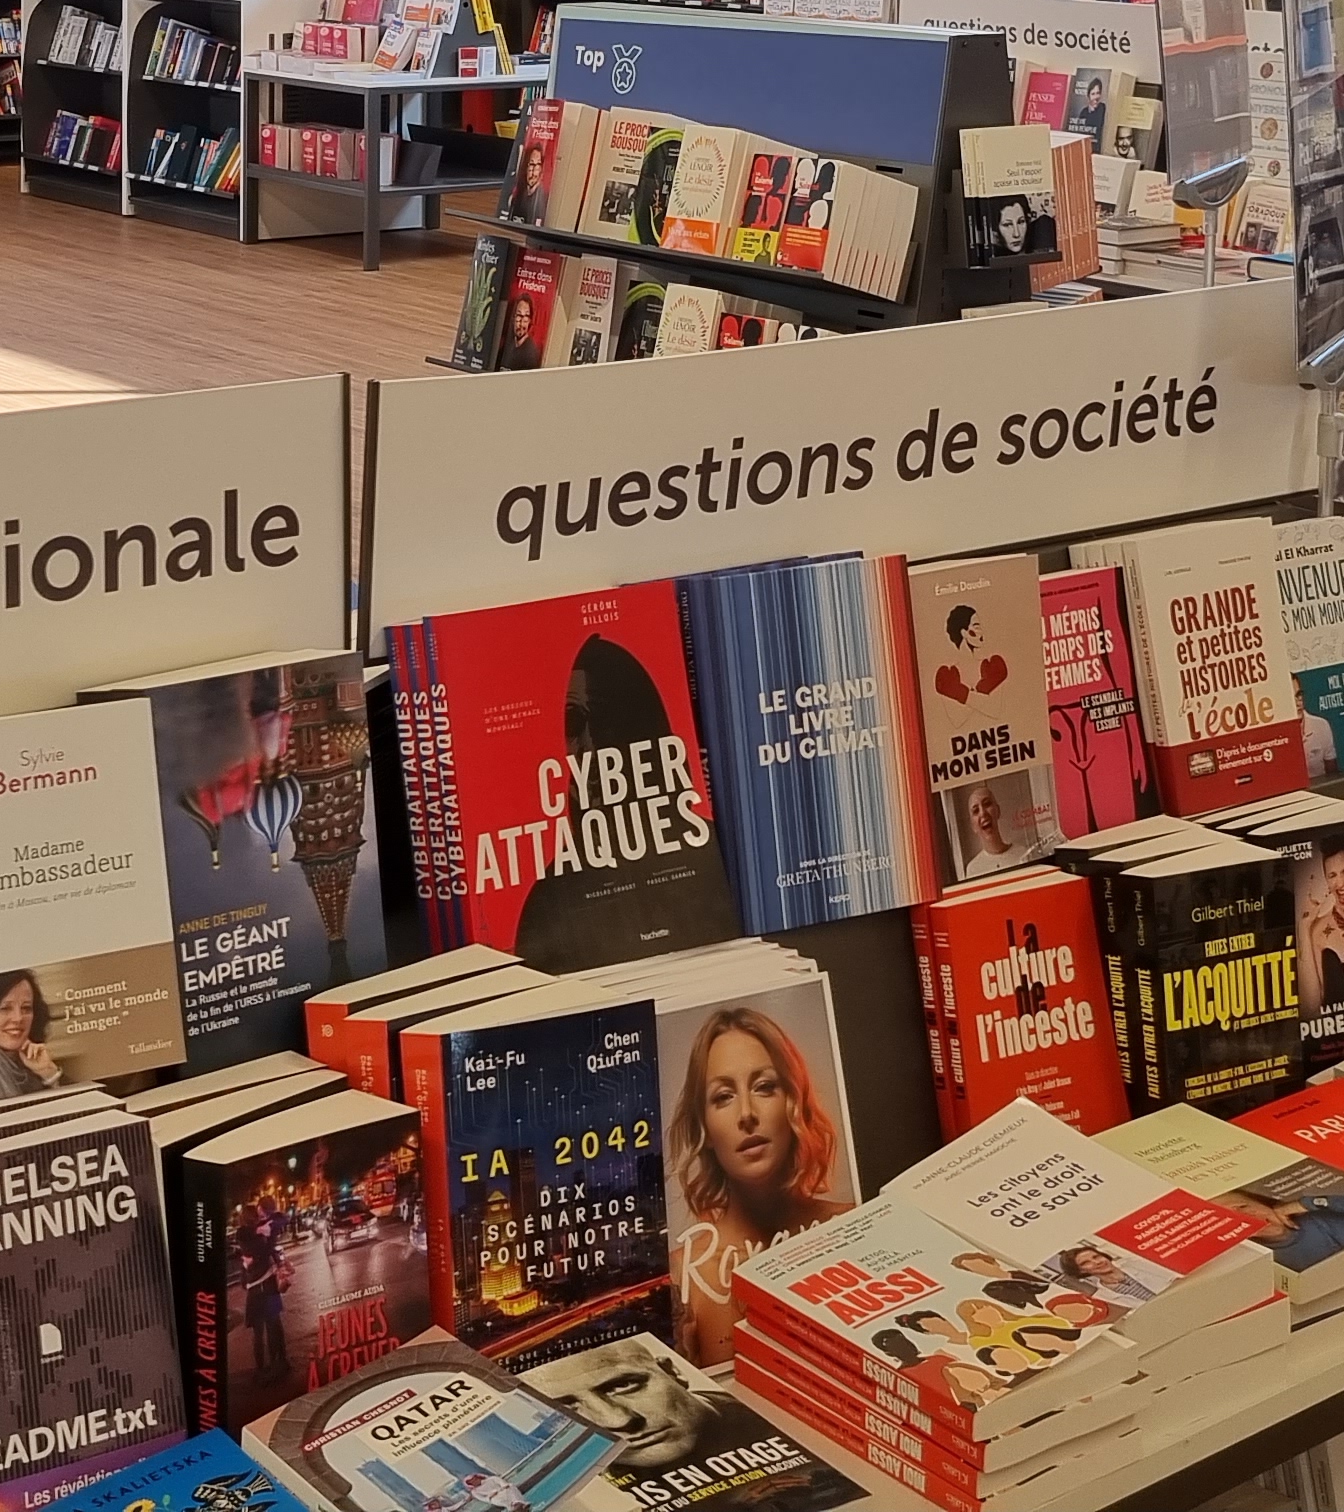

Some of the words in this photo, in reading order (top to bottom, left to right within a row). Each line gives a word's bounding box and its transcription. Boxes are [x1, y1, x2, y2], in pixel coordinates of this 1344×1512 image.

[575, 45, 605, 73] Top
[1023, 22, 1048, 46] de
[1054, 27, 1132, 54] société
[495, 432, 876, 562] questions
[894, 407, 982, 481] de
[997, 365, 1218, 469] société
[758, 688, 788, 715] LE
[795, 677, 878, 709] GRAND
[789, 706, 855, 736] LIVRE
[20, 746, 65, 771] Sylvie
[758, 740, 791, 767] DU
[799, 725, 888, 761] CLIMAT
[538, 735, 694, 818] CYBER
[474, 790, 710, 895] ATTAQUES
[181, 938, 210, 963] LE
[215, 917, 291, 953] GÉANT
[184, 944, 286, 992] EMPÊTRÉ
[981, 944, 1075, 1001] culture
[1163, 935, 1299, 1033] L'ACQUITTÉ
[976, 996, 1096, 1063] l'inceste
[460, 1148, 510, 1183] IA
[554, 1120, 650, 1166] 2042
[788, 1259, 875, 1306] MOI
[824, 1266, 942, 1326] AUSSI
[371, 1377, 476, 1444] QATAR
